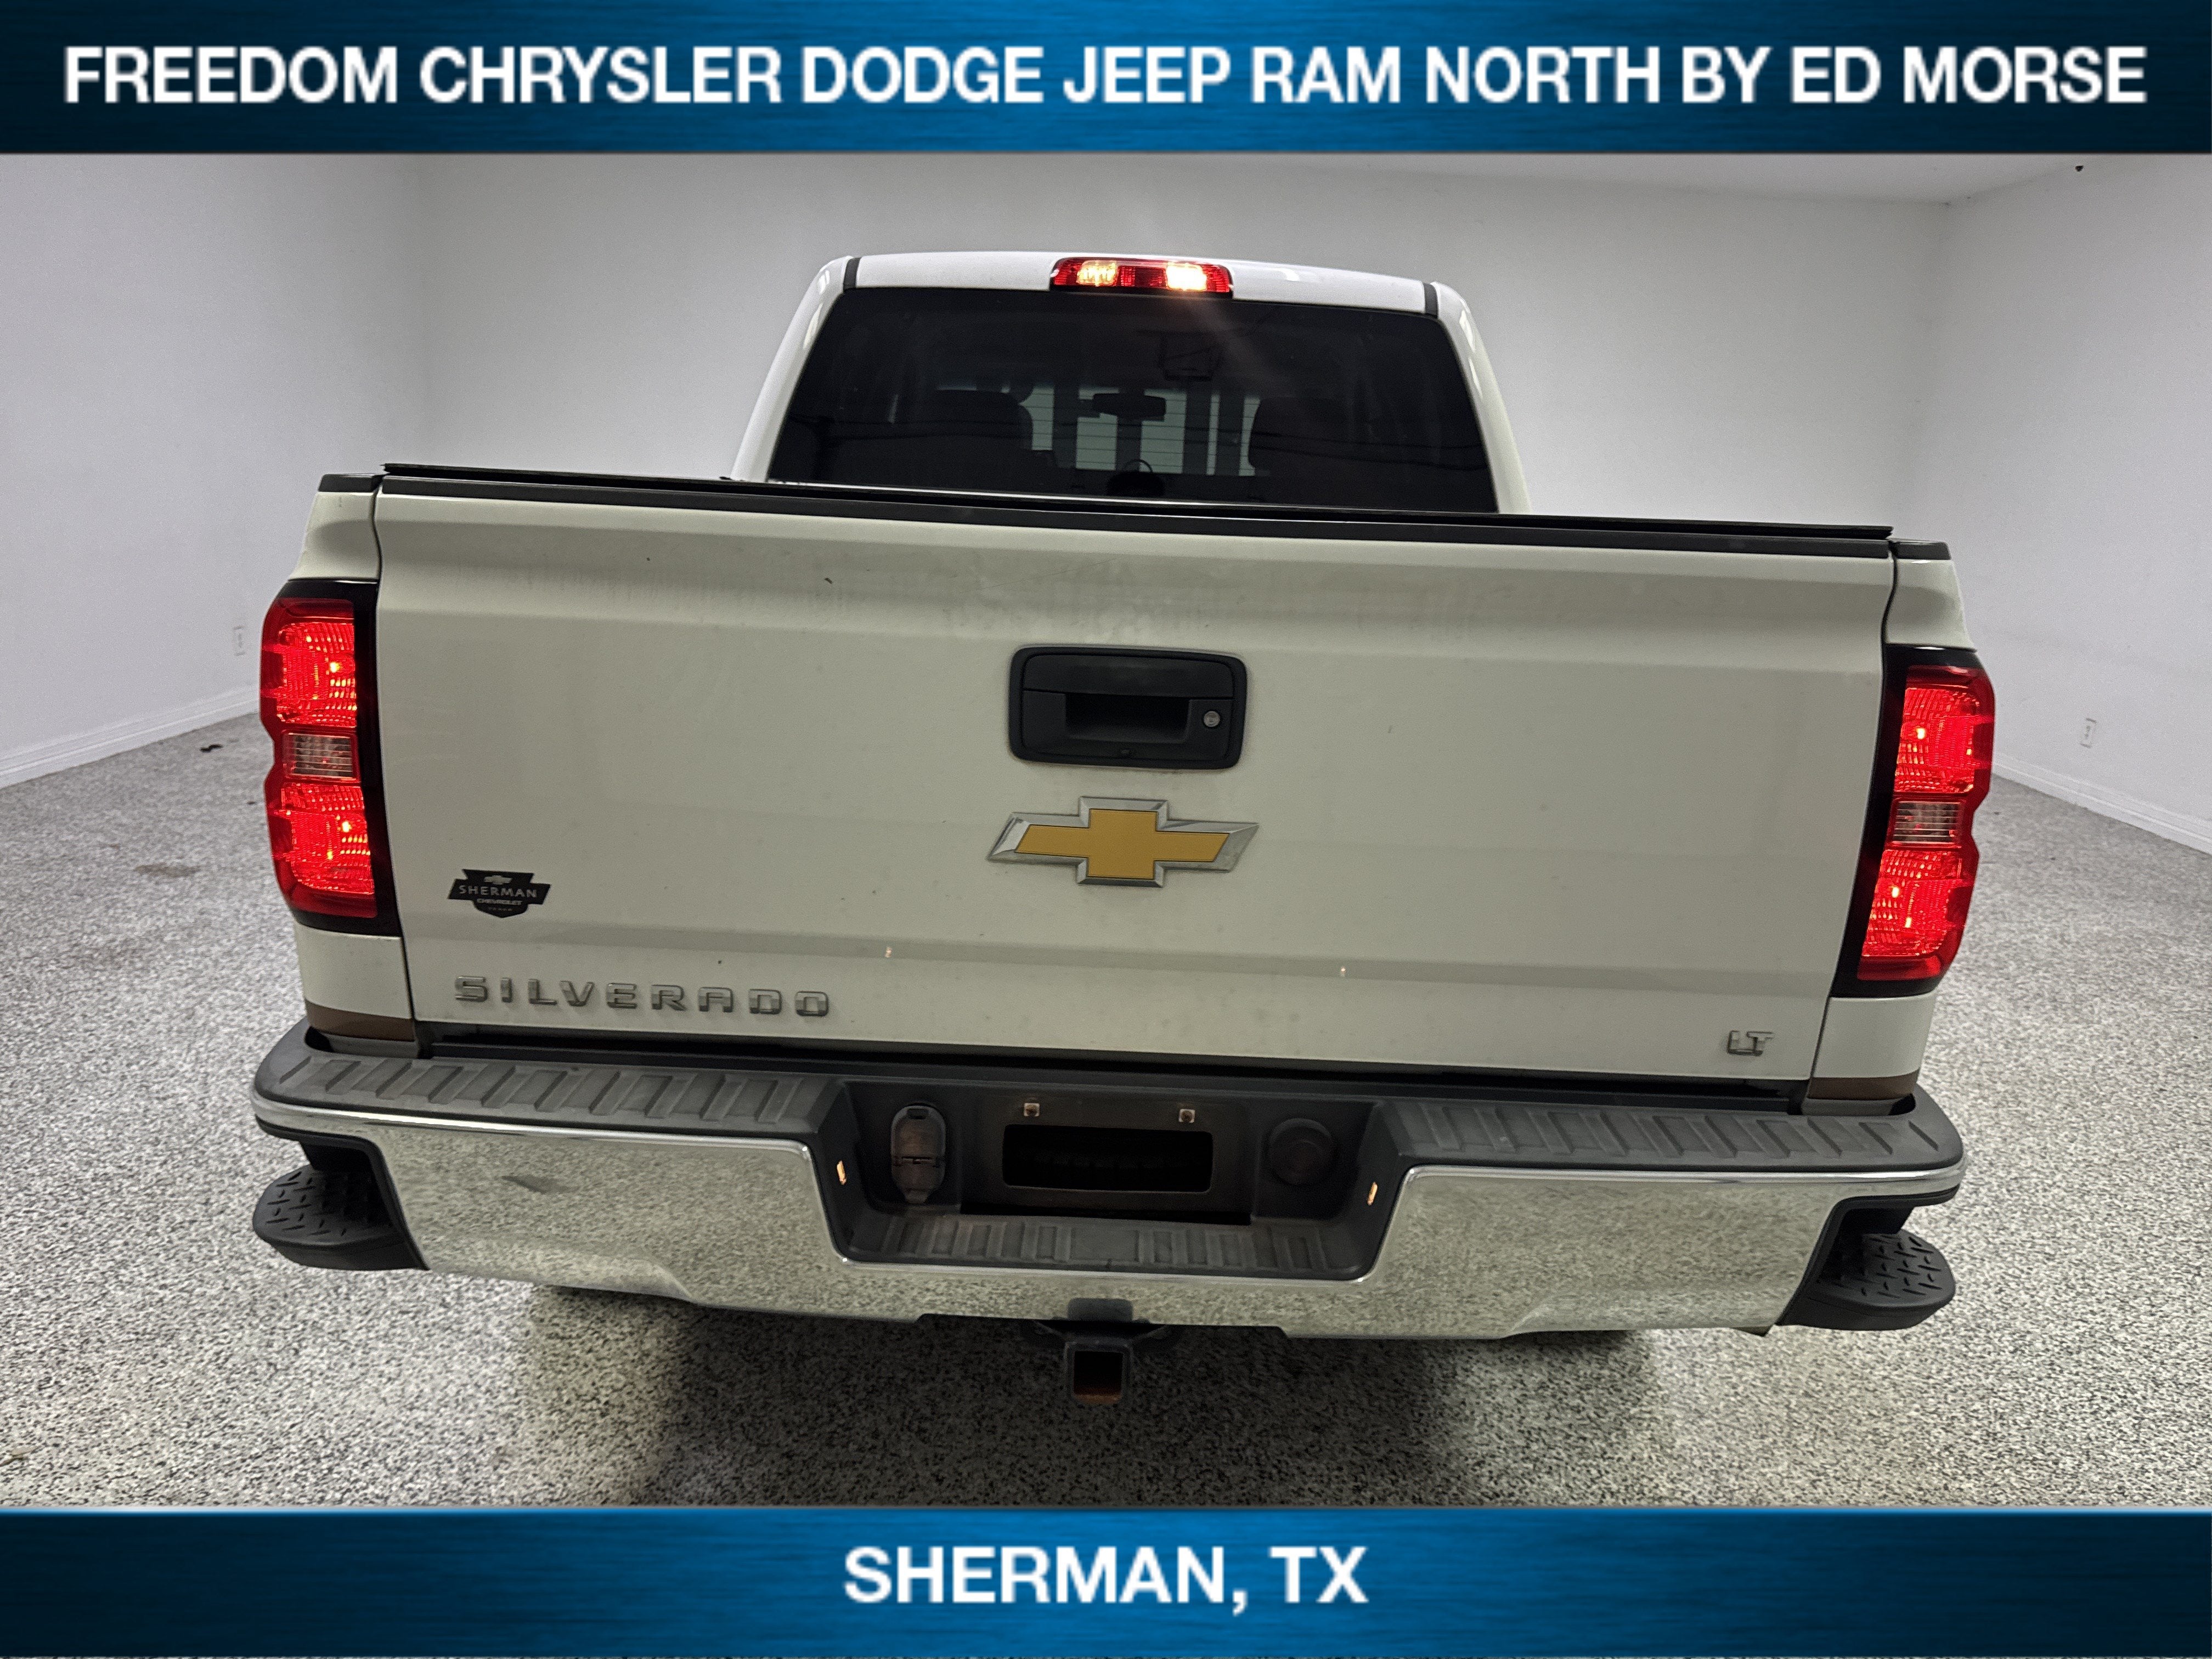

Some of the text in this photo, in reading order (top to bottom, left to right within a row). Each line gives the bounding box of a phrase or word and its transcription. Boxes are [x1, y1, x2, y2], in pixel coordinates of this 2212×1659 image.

[459, 885, 538, 898] SHERMAN
[454, 975, 830, 1017] SILVERADO
[1727, 1030, 1775, 1057] LT
